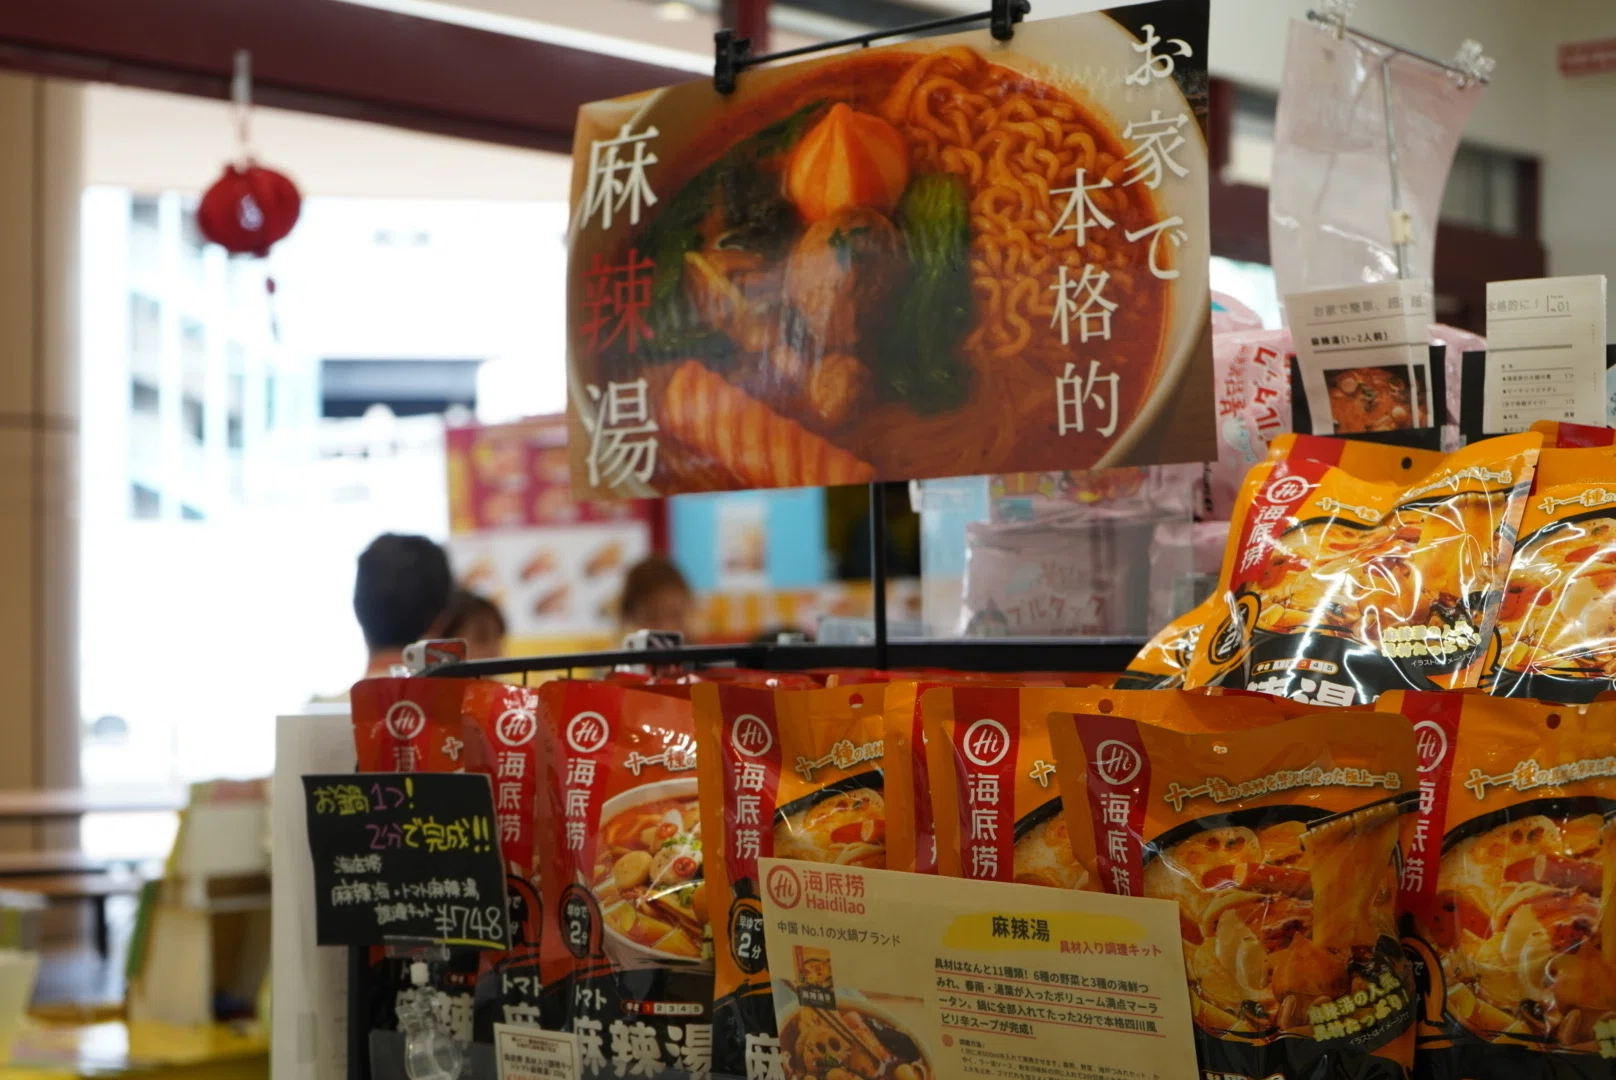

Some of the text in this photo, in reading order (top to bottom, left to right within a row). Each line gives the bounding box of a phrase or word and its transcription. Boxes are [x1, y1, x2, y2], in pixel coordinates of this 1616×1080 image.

[1120, 24, 1193, 281] お家で
[579, 122, 660, 489] 麻辣湯
[1048, 168, 1119, 438] 本格的
[564, 757, 597, 851] 海底捞
[733, 761, 767, 860] 海底捞
[967, 773, 1000, 879] 海底捞
[1101, 792, 1131, 896] 海底捞
[803, 869, 865, 899] 海底捞
[805, 894, 866, 916] Haidilao
[738, 932, 762, 959] 2分
[777, 920, 798, 935] 中国
[992, 915, 1050, 943] 麻辣湯
[1059, 940, 1162, 957] 具材入り調理キット
[502, 973, 543, 998] トマト
[574, 983, 608, 1010] トマト
[574, 1015, 713, 1080] 麻辣湯
